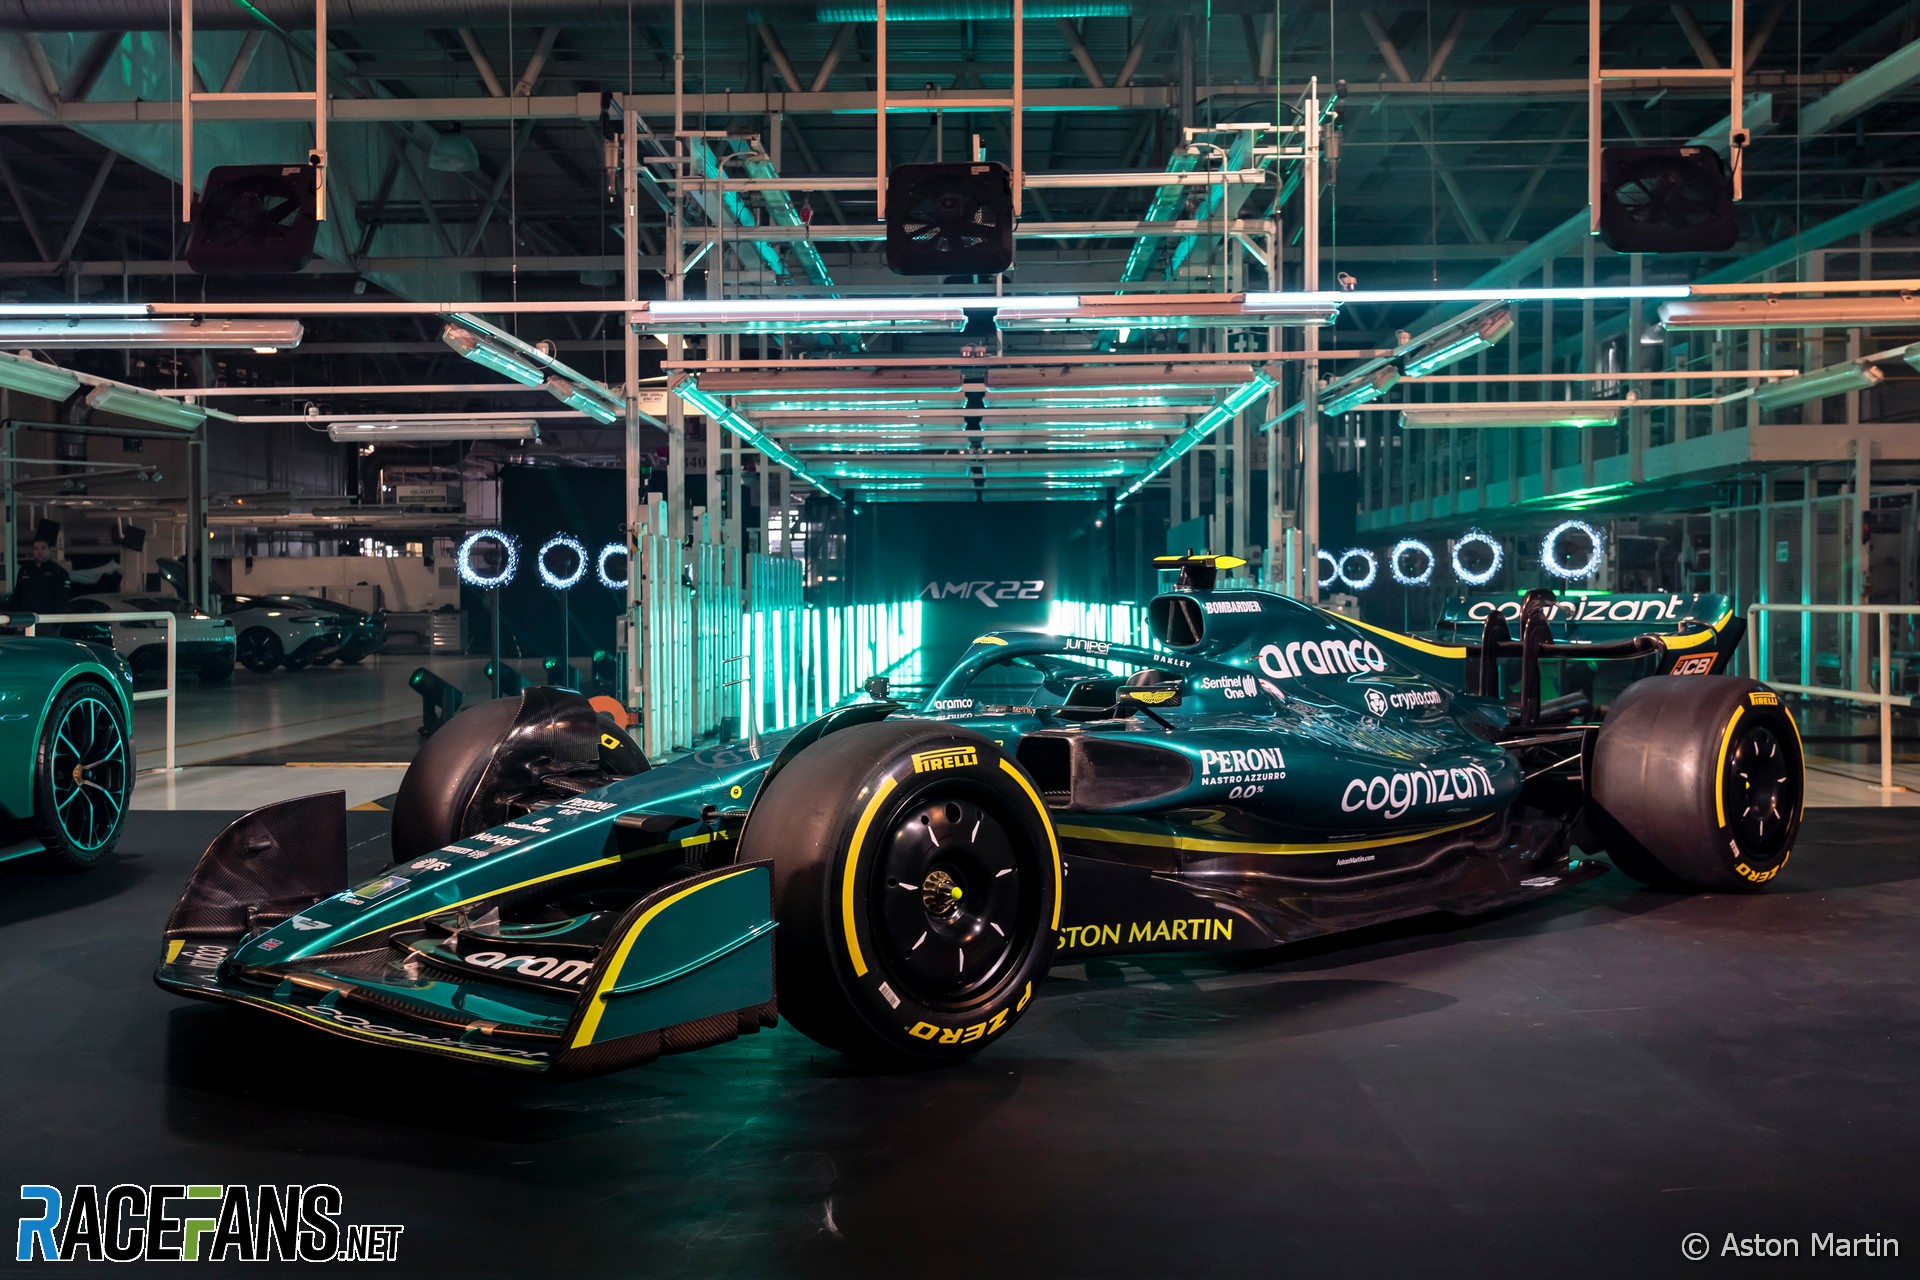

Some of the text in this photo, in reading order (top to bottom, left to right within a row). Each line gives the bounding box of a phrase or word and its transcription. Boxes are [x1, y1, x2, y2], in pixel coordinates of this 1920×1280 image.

[1206, 601, 1262, 615] BOMBARDIER
[1468, 595, 1683, 621] conizant
[1153, 653, 1191, 669] OAKLEY
[1258, 639, 1385, 679] aramco
[1673, 658, 1711, 676] JCB
[1203, 675, 1242, 689] Sentinel
[1224, 689, 1245, 700] One
[1390, 690, 1442, 710] crypto.com
[1749, 692, 1778, 706] PIRELLI
[935, 698, 973, 710] aramco
[911, 746, 979, 774] PIRELLI
[1200, 747, 1286, 775] PERONI
[1202, 771, 1287, 786] NASTRO AZZURRO
[1228, 784, 1265, 800] 0.0%
[1341, 763, 1496, 820] cognizant
[469, 832, 521, 847] NetApp
[1336, 854, 1376, 867] AstonMartin.com
[1735, 863, 1780, 883] ZERO
[1056, 918, 1233, 950] STON MARTIN
[464, 951, 595, 985] aram
[908, 980, 1032, 1045] P ZERO
